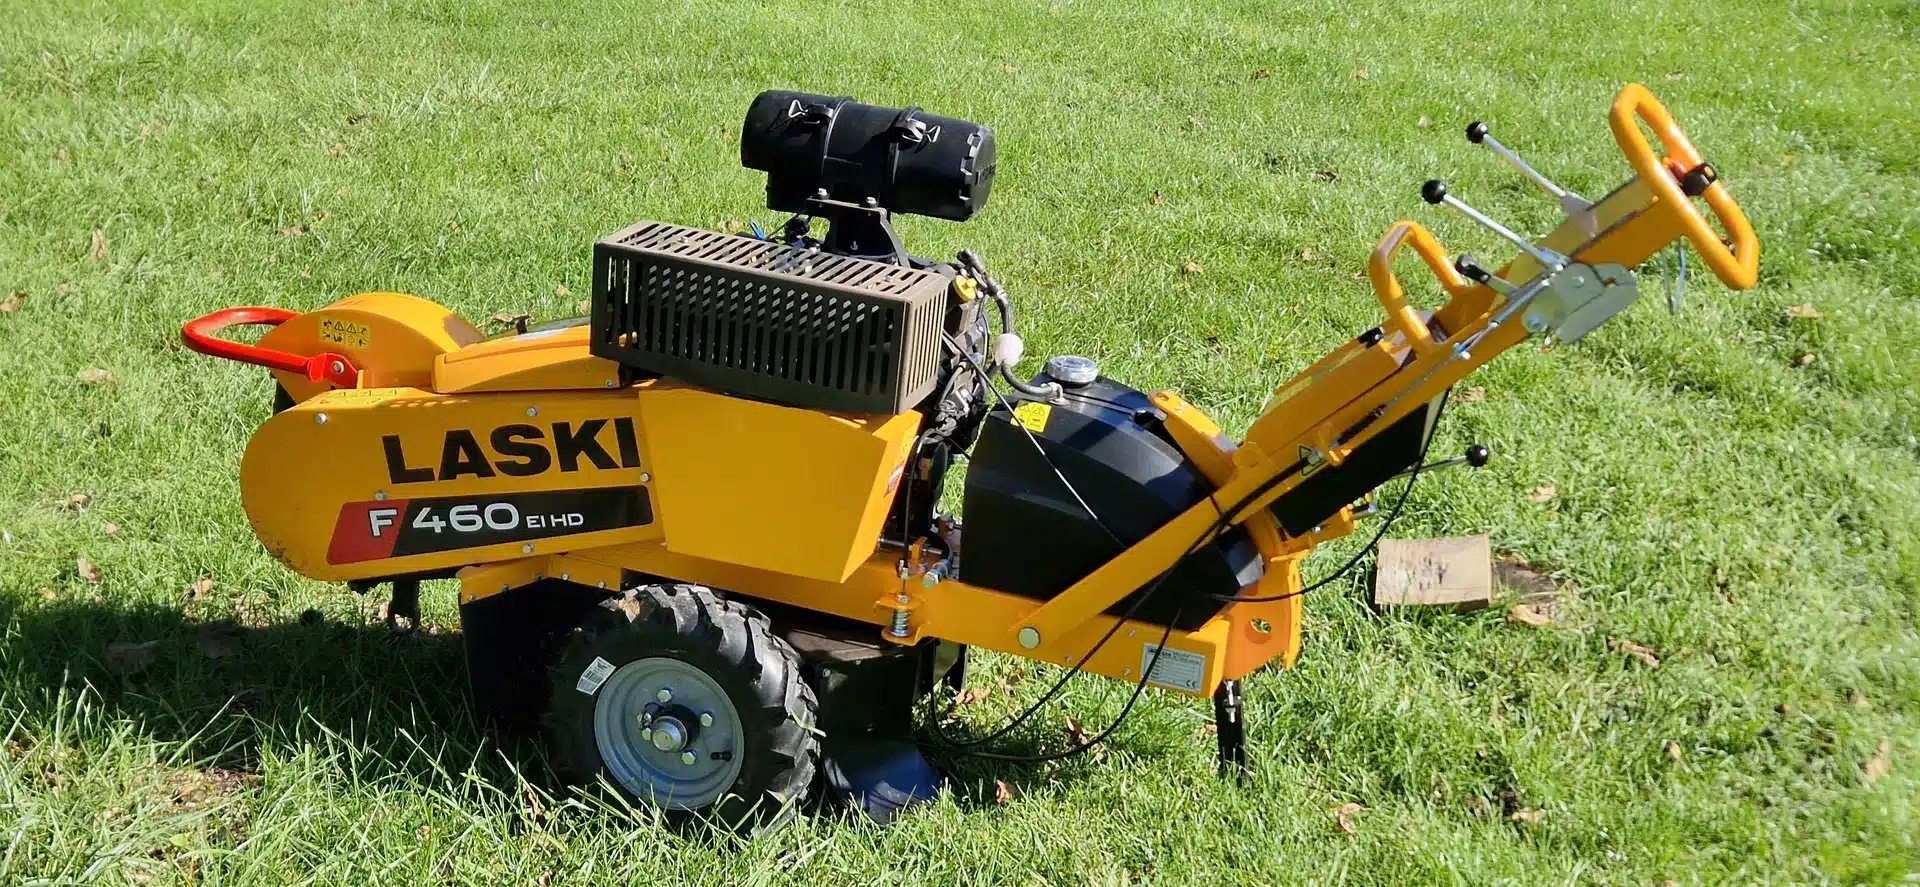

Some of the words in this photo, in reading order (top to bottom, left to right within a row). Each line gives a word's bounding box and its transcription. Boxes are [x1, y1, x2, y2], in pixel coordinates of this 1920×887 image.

[381, 417, 641, 484] LASKI
[368, 508, 398, 537] F
[412, 502, 520, 533] 460
[526, 515, 546, 528] EI
[551, 513, 584, 526] HD
